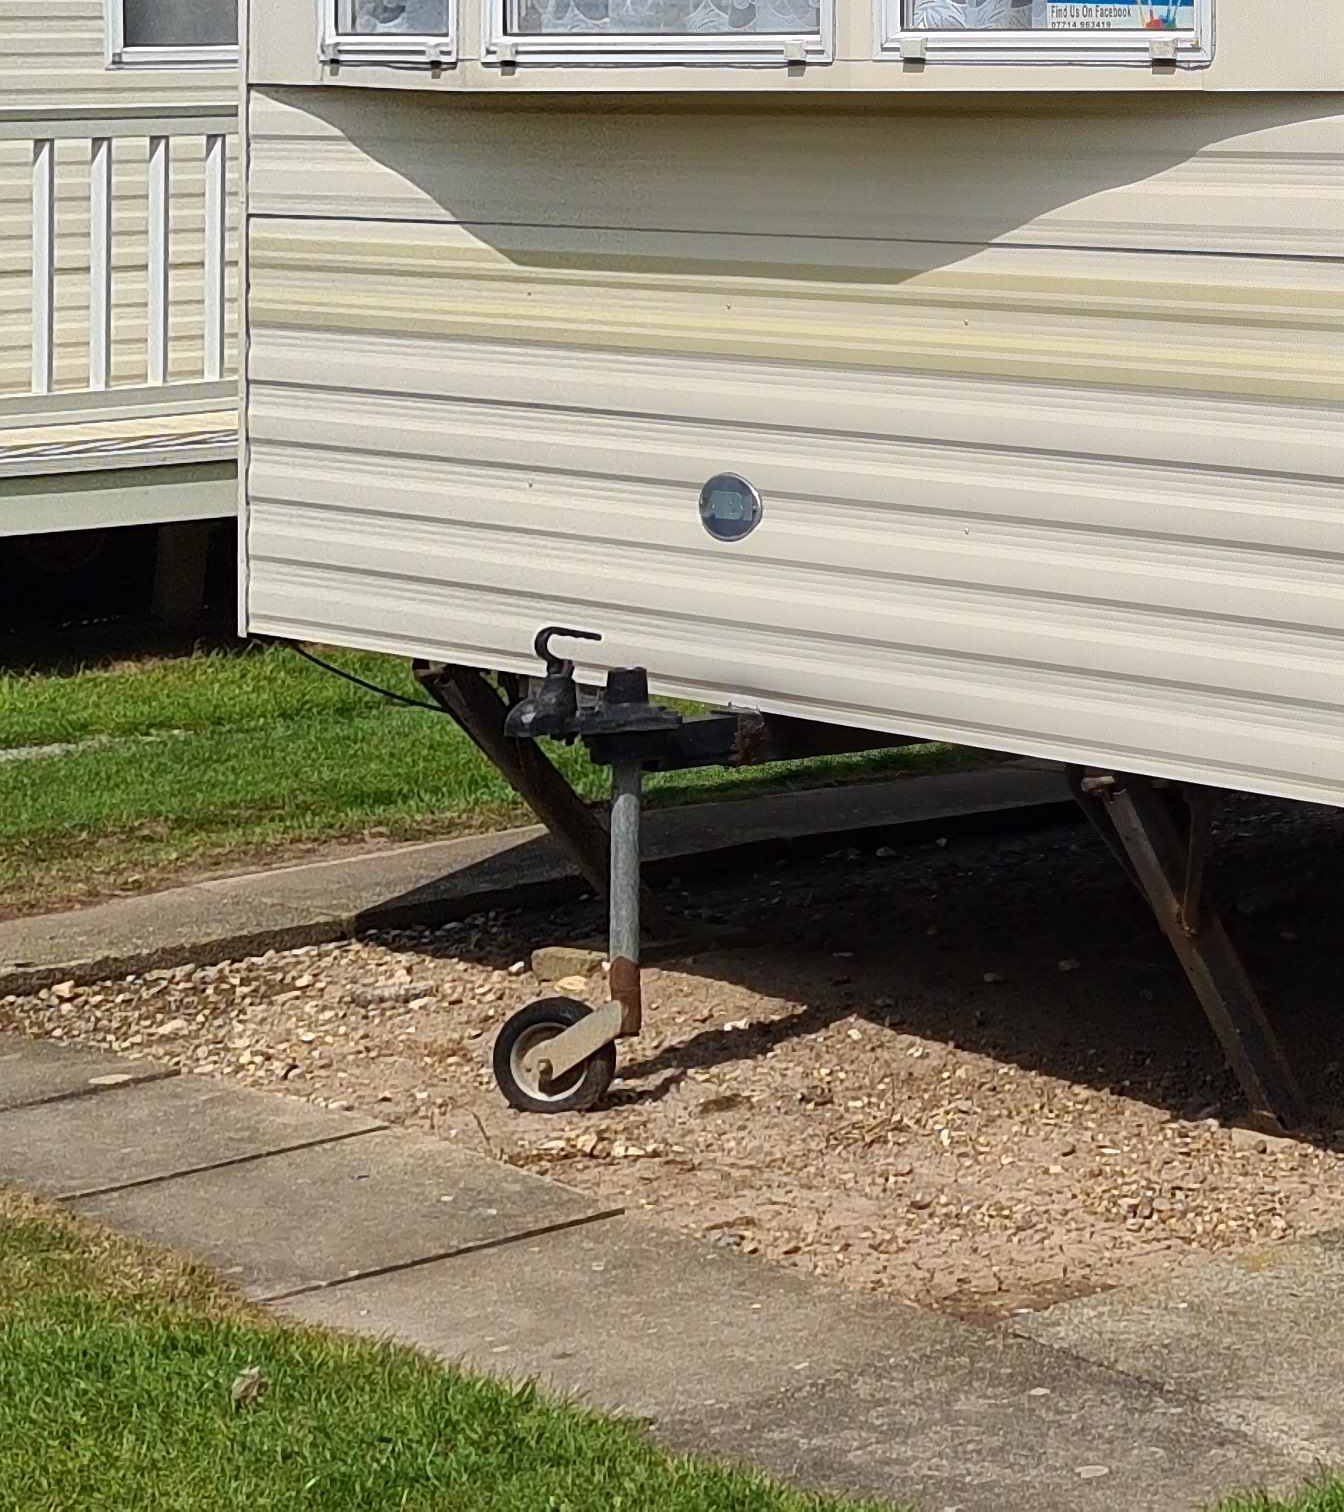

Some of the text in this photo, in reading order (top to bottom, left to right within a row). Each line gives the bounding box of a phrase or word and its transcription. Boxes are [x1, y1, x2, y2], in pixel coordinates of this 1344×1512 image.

[1051, 4, 1132, 18] Find Us On Facebook
